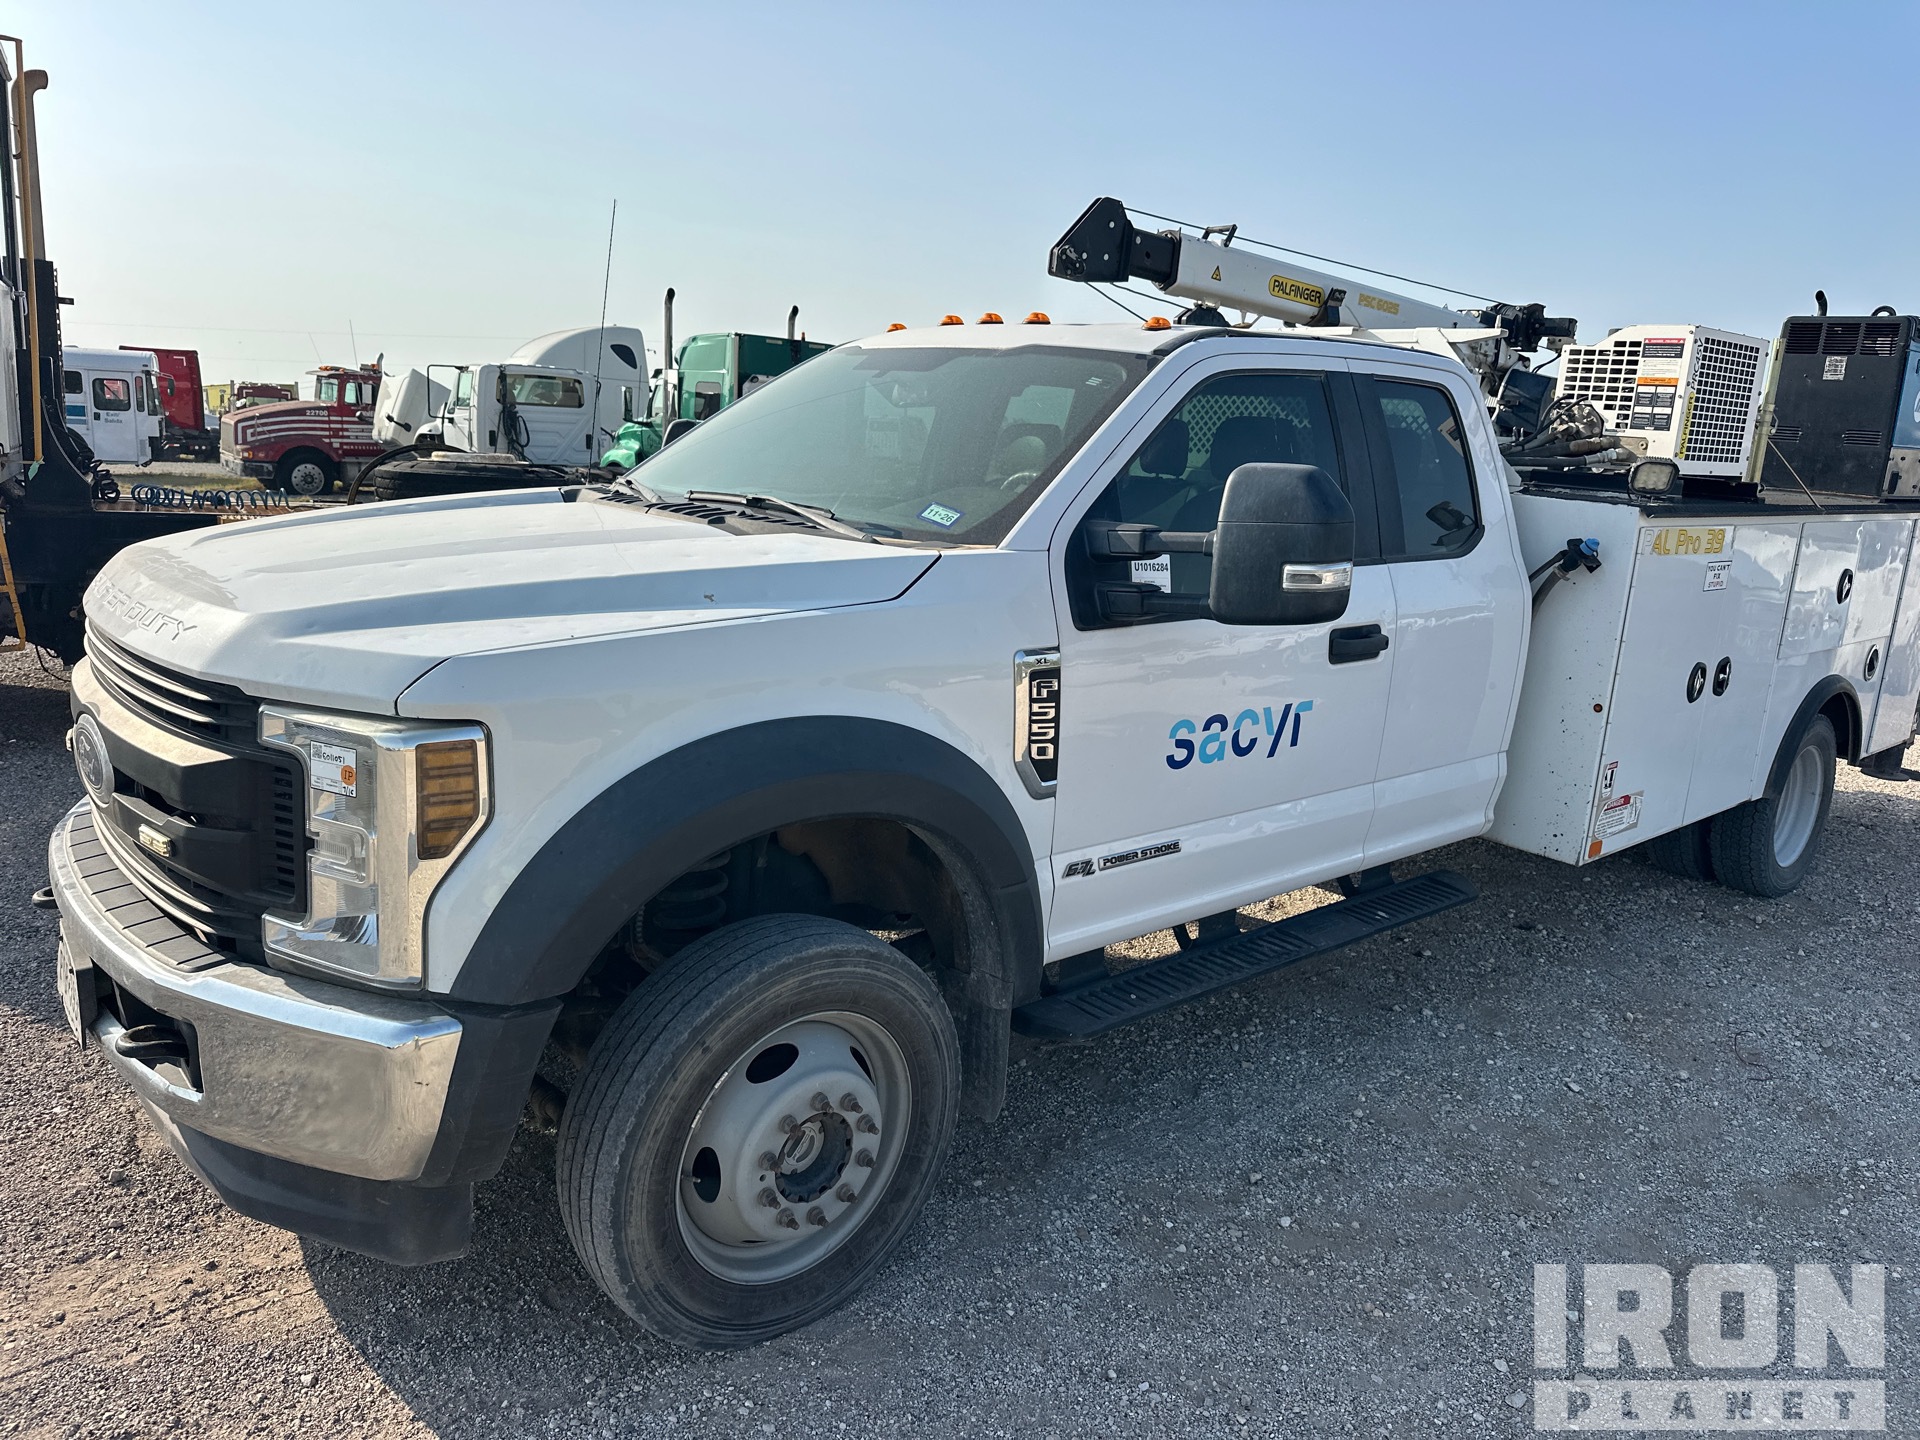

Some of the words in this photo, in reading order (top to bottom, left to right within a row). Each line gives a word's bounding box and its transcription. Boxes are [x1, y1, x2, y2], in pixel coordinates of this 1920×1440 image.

[1272, 279, 1322, 304] PALFINGER
[1680, 396, 1694, 455] PALFINGER
[1675, 529, 1701, 555] Pro
[1704, 529, 1725, 554] 39
[1134, 562, 1169, 572] U1016284
[123, 601, 198, 642] DUTY
[1030, 679, 1059, 760] F550
[1165, 700, 1314, 770] sacyr
[1103, 851, 1139, 867] POWER
[1140, 841, 1180, 858] STROKE
